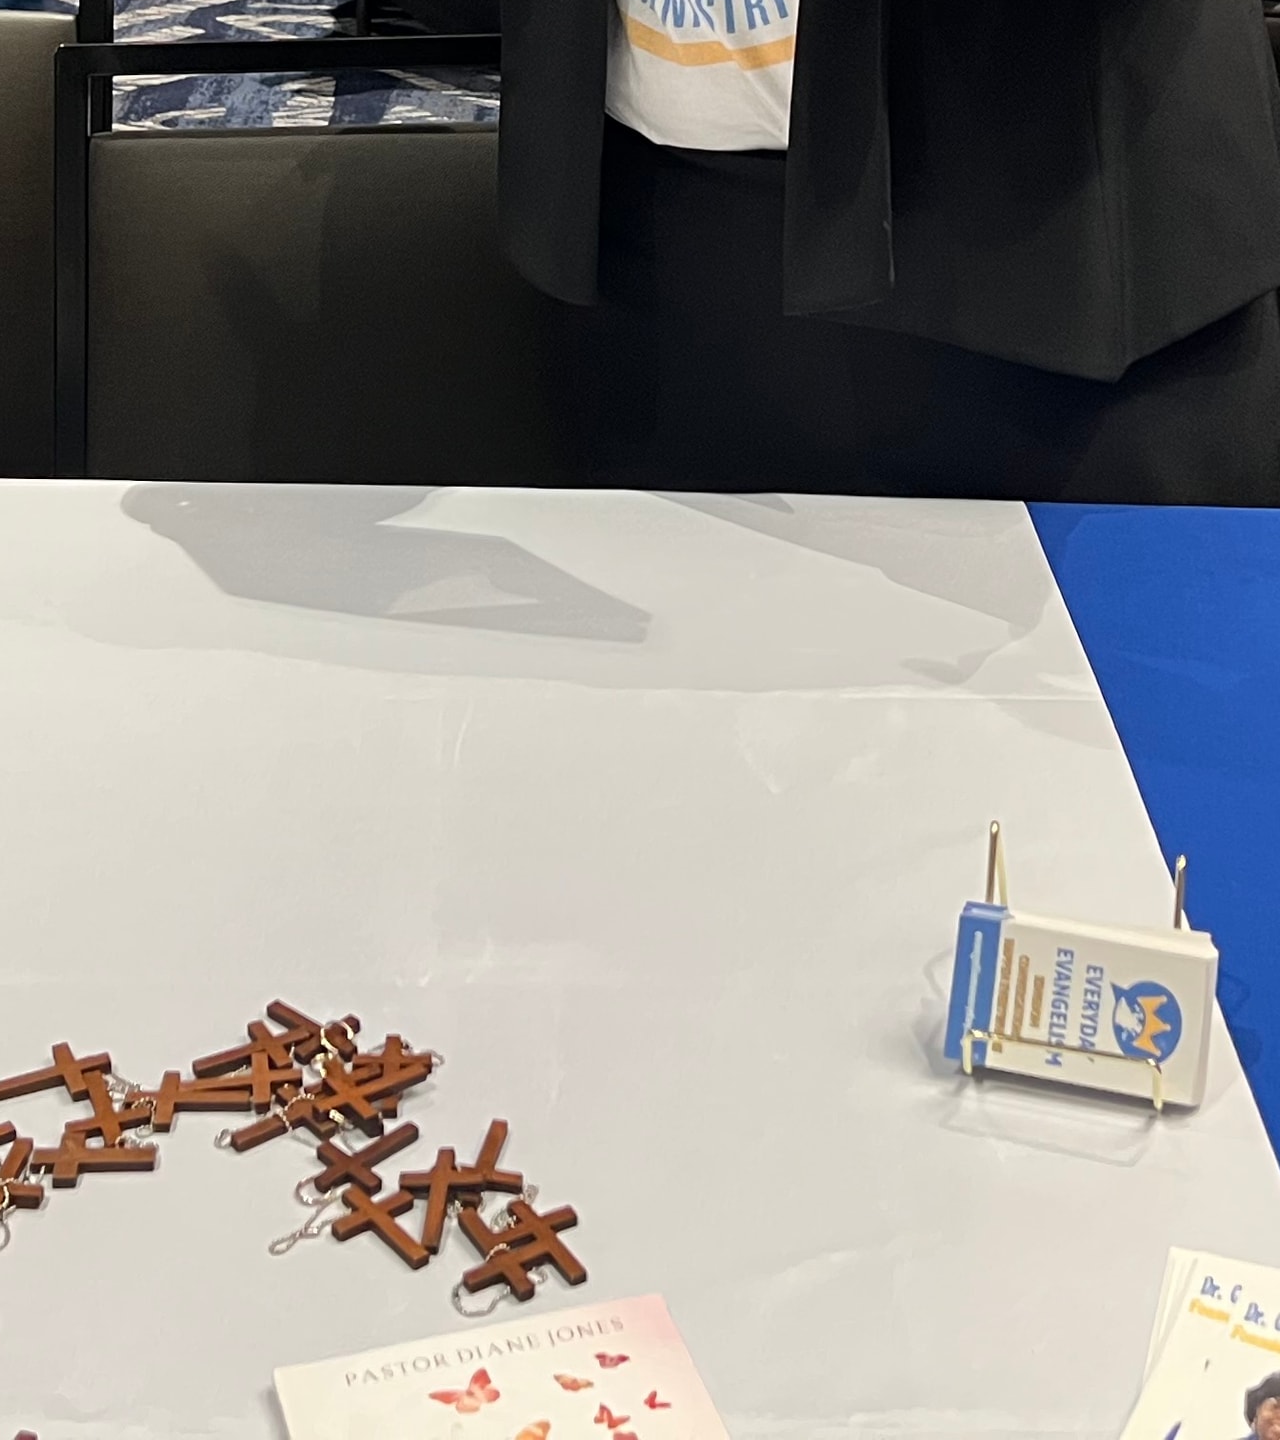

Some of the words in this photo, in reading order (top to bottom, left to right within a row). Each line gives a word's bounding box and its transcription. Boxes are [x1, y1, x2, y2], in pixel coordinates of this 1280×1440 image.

[1200, 1276, 1223, 1301] Dr.
[1244, 1301, 1267, 1327] Dr.
[345, 1352, 450, 1388] PASTOR
[456, 1334, 542, 1364] DIANE
[546, 1315, 626, 1348] JONES
